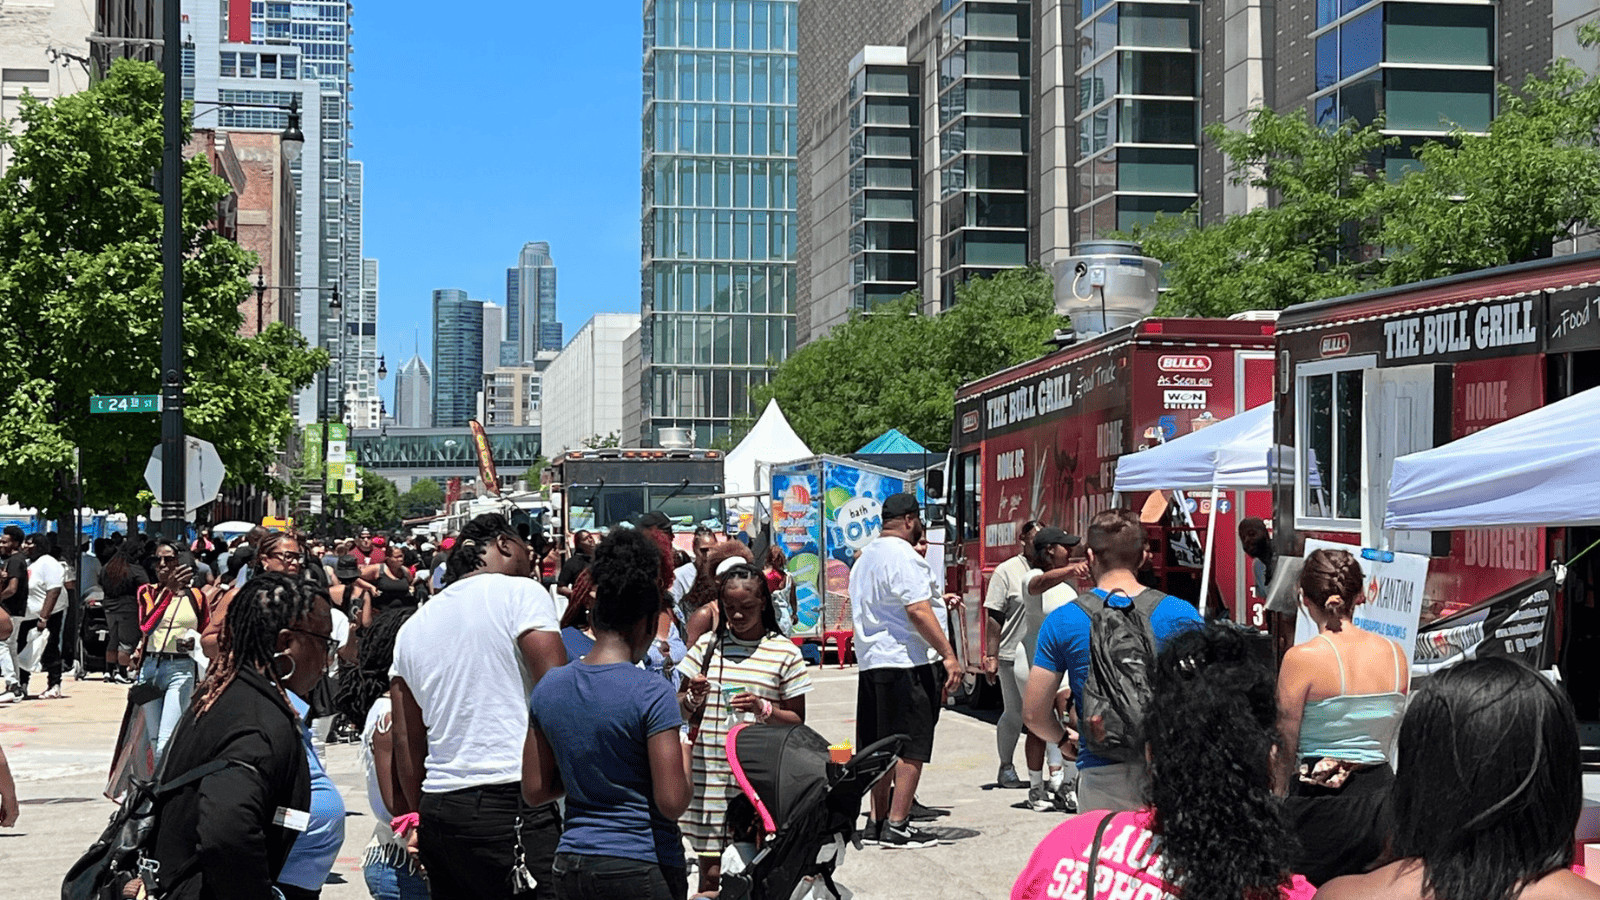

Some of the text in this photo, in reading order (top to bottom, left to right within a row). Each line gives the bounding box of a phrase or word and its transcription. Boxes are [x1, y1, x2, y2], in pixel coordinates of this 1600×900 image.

[1384, 300, 1536, 359] THE BULL GRILL
[1560, 297, 1590, 336] Food
[144, 400, 152, 408] ST
[986, 373, 1073, 430] THE BULL GRILL
[1465, 380, 1508, 421] HOME
[1097, 420, 1123, 458] HOME
[849, 504, 868, 518] bath
[832, 515, 883, 547] BOM
[1464, 526, 1538, 571] BURGER
[1377, 576, 1414, 613] KANTINA
[1047, 857, 1179, 900] SEPHO
